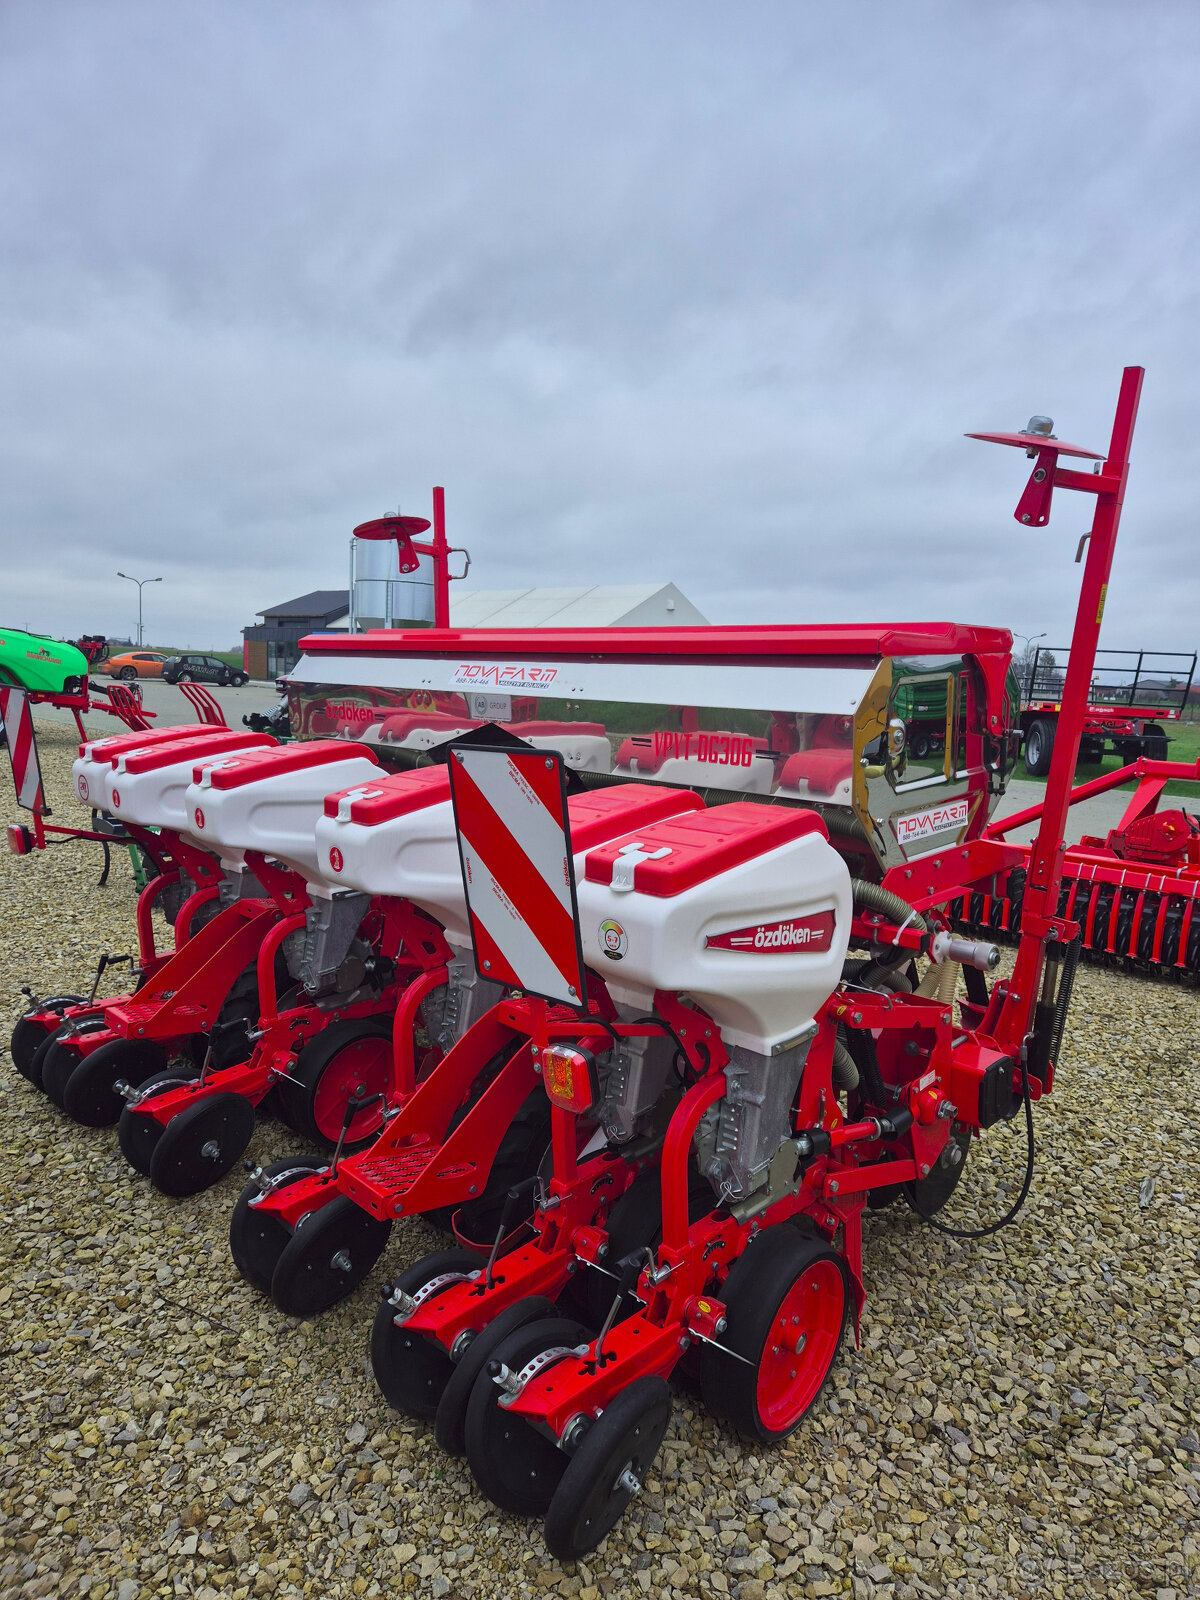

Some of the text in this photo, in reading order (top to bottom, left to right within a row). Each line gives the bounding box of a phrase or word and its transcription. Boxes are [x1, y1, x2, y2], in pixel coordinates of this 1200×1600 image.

[454, 664, 558, 686] NOVAFARM
[325, 699, 375, 722] özdöken
[898, 804, 967, 835] NOVAFARM
[754, 923, 811, 948] özdöken
